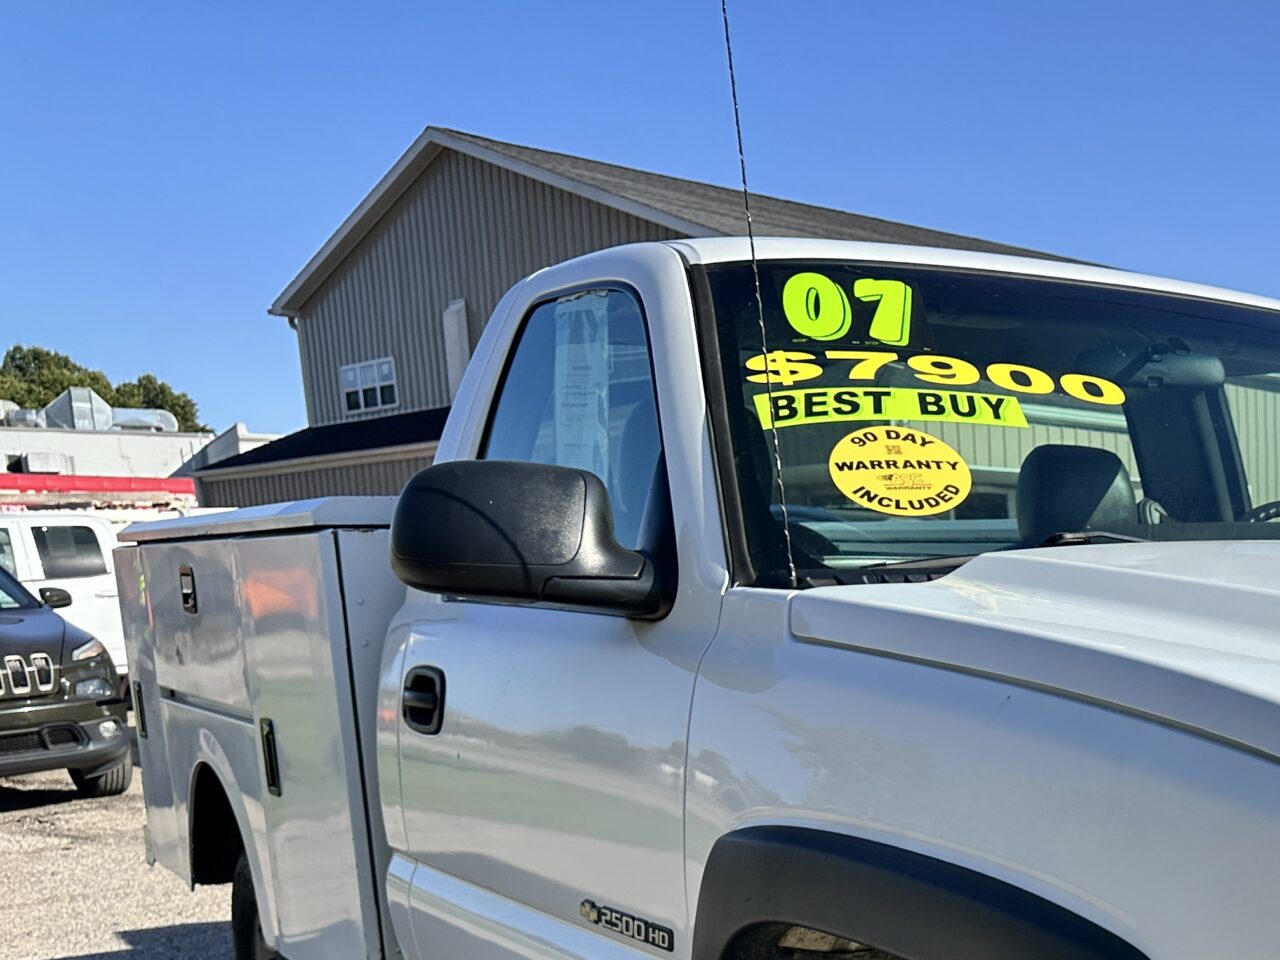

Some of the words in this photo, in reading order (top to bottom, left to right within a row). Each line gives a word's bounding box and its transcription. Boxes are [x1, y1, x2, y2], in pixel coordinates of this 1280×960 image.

[782, 272, 912, 346] 07
[745, 350, 1126, 405] $7900
[771, 391, 891, 422] BEST
[917, 392, 1005, 420] BUY
[850, 431, 878, 447] 90
[885, 430, 935, 447] DAY
[834, 459, 959, 472] WARRANTY
[852, 484, 960, 510] INCLUDED
[601, 908, 646, 941] 2500
[648, 927, 669, 948] HD
